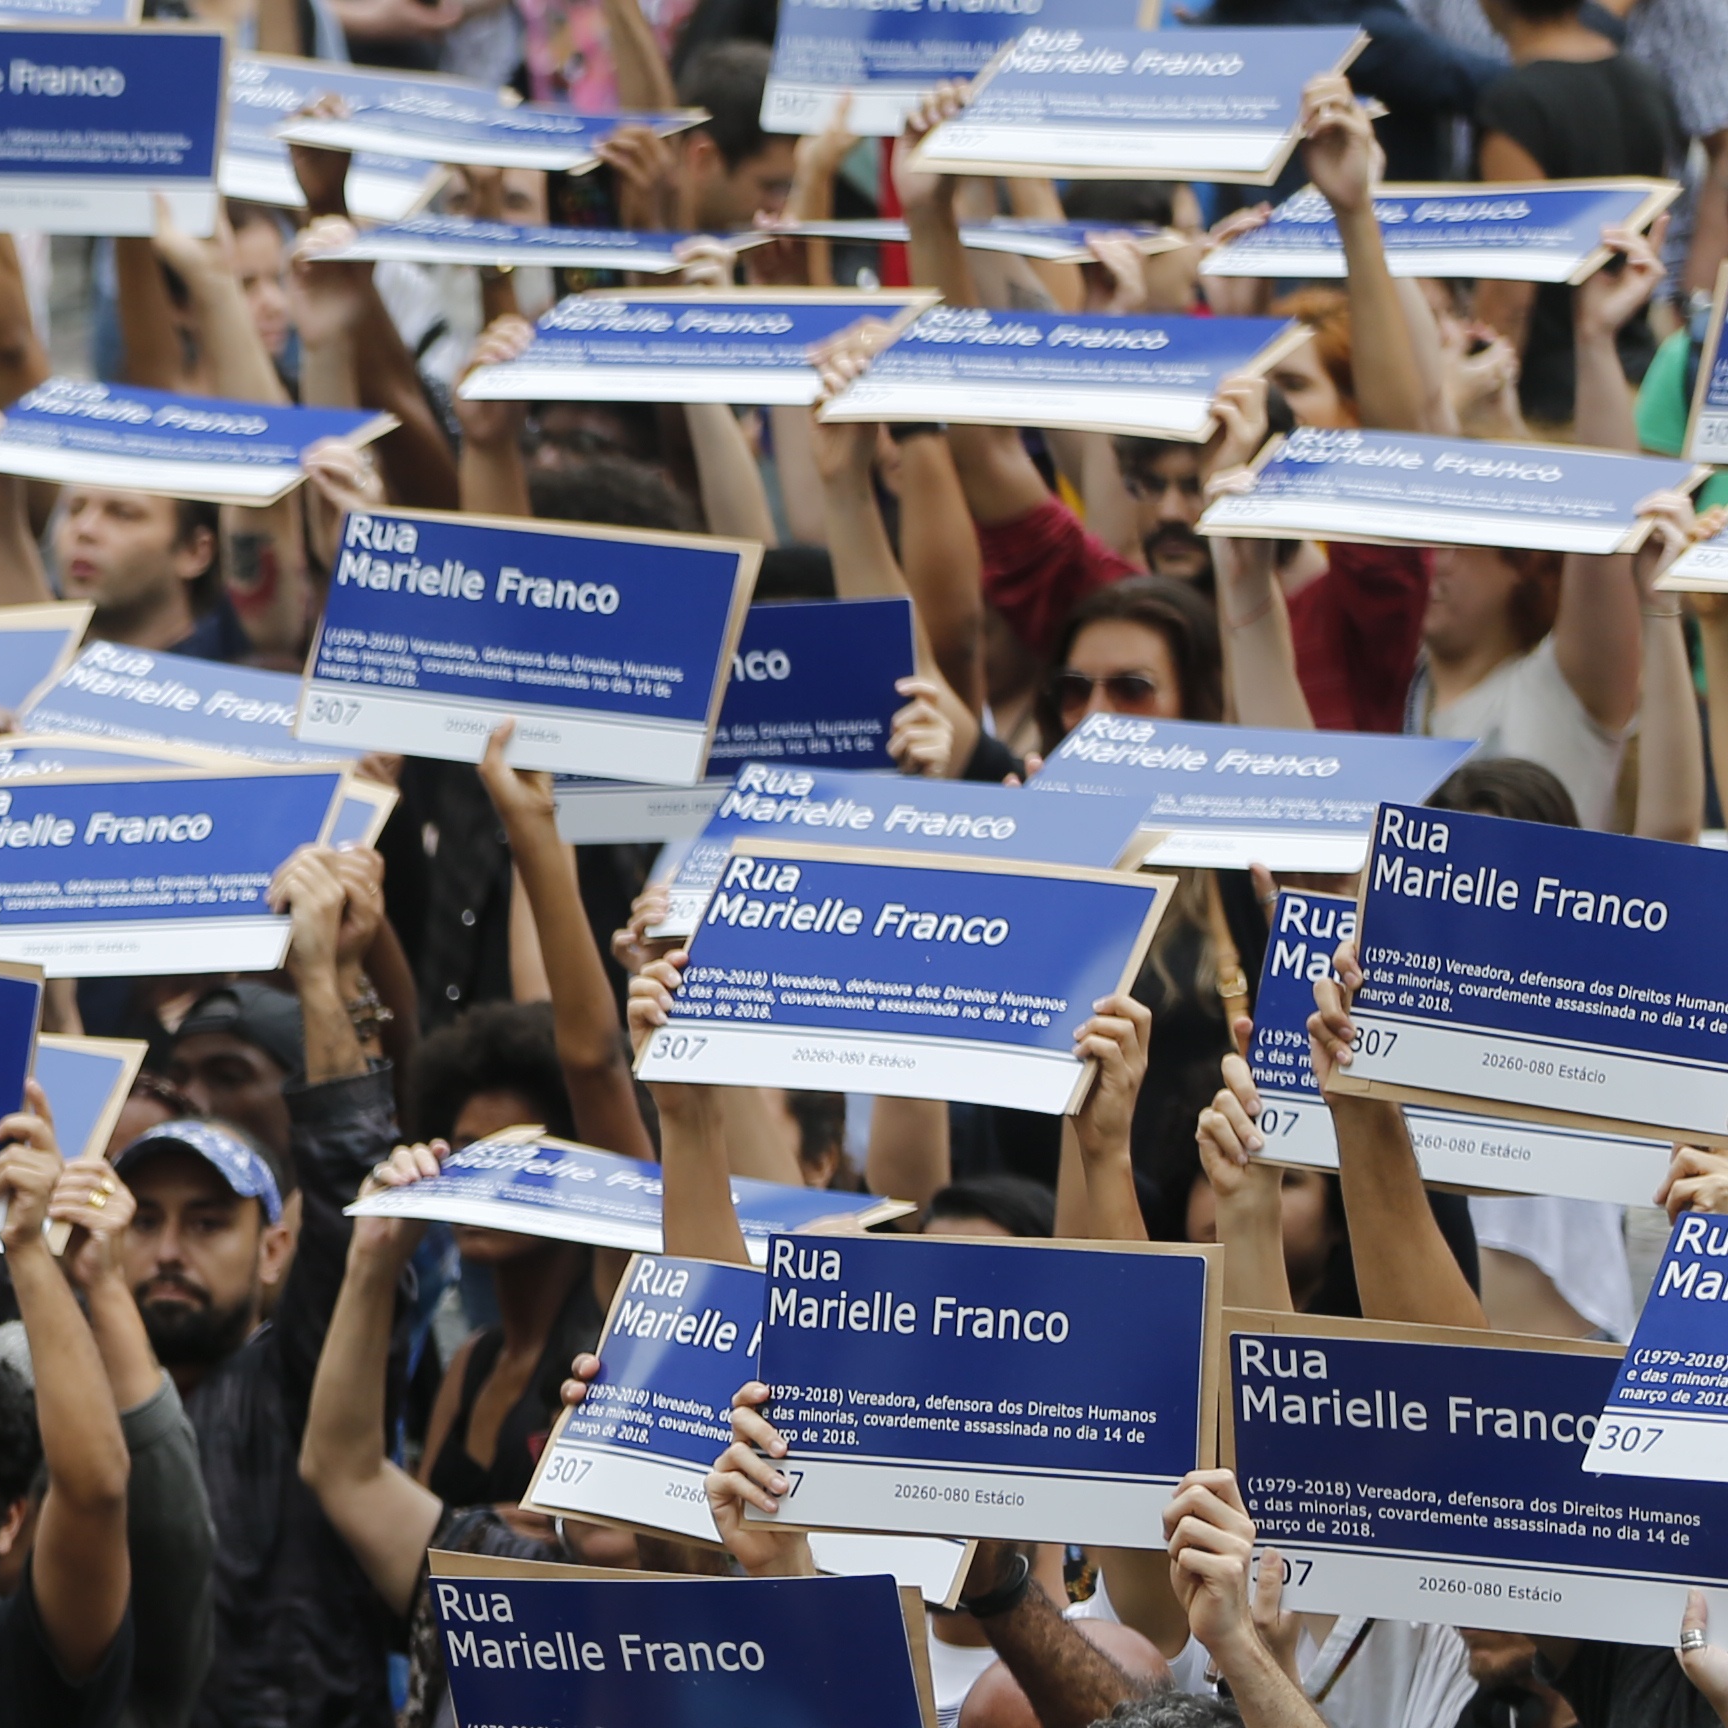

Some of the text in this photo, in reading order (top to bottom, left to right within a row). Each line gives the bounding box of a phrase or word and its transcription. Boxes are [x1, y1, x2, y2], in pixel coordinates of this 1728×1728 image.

[346, 511, 421, 553] Rua
[338, 550, 619, 614] Marielle Franco
[1081, 713, 1156, 744] Rua
[1060, 736, 1341, 779] Marielle Franco
[84, 812, 214, 846] Franco
[1381, 808, 1448, 853] Rua
[725, 854, 800, 892] Rua
[1375, 854, 1667, 931] Marielle Franco
[708, 893, 1008, 945] Marielle Franco
[773, 1240, 840, 1280] Rua
[770, 1288, 1068, 1343] Marielle Franco
[1239, 1339, 1328, 1379] Rua
[1241, 1385, 1599, 1446] Marielle Franco
[1599, 1425, 1664, 1454] 307
[437, 1584, 513, 1622] Rua
[1419, 1576, 1563, 1603] 20260-080 Estácio
[447, 1631, 764, 1672] Marielle Franco
